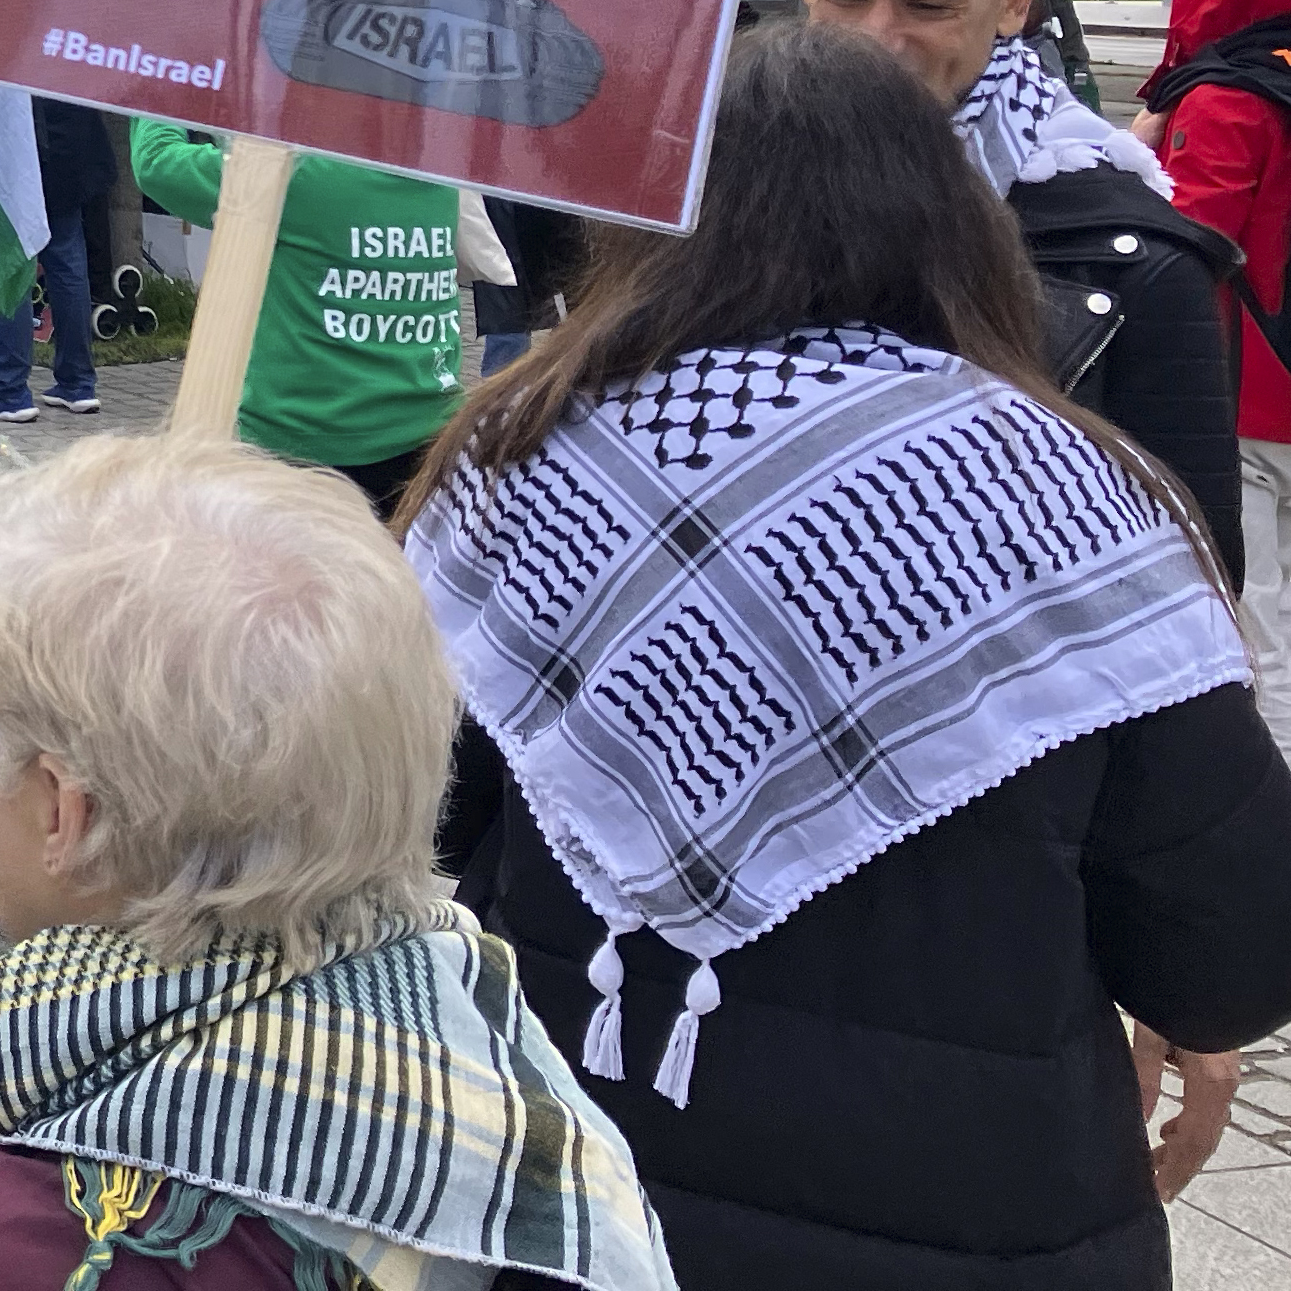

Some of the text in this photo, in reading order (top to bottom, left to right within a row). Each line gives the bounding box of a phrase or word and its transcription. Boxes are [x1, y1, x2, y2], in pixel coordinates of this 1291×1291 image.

[41, 27, 227, 91] #BanIsrael
[345, 8, 519, 75] ISRAEL
[350, 226, 455, 259] ISRAEL
